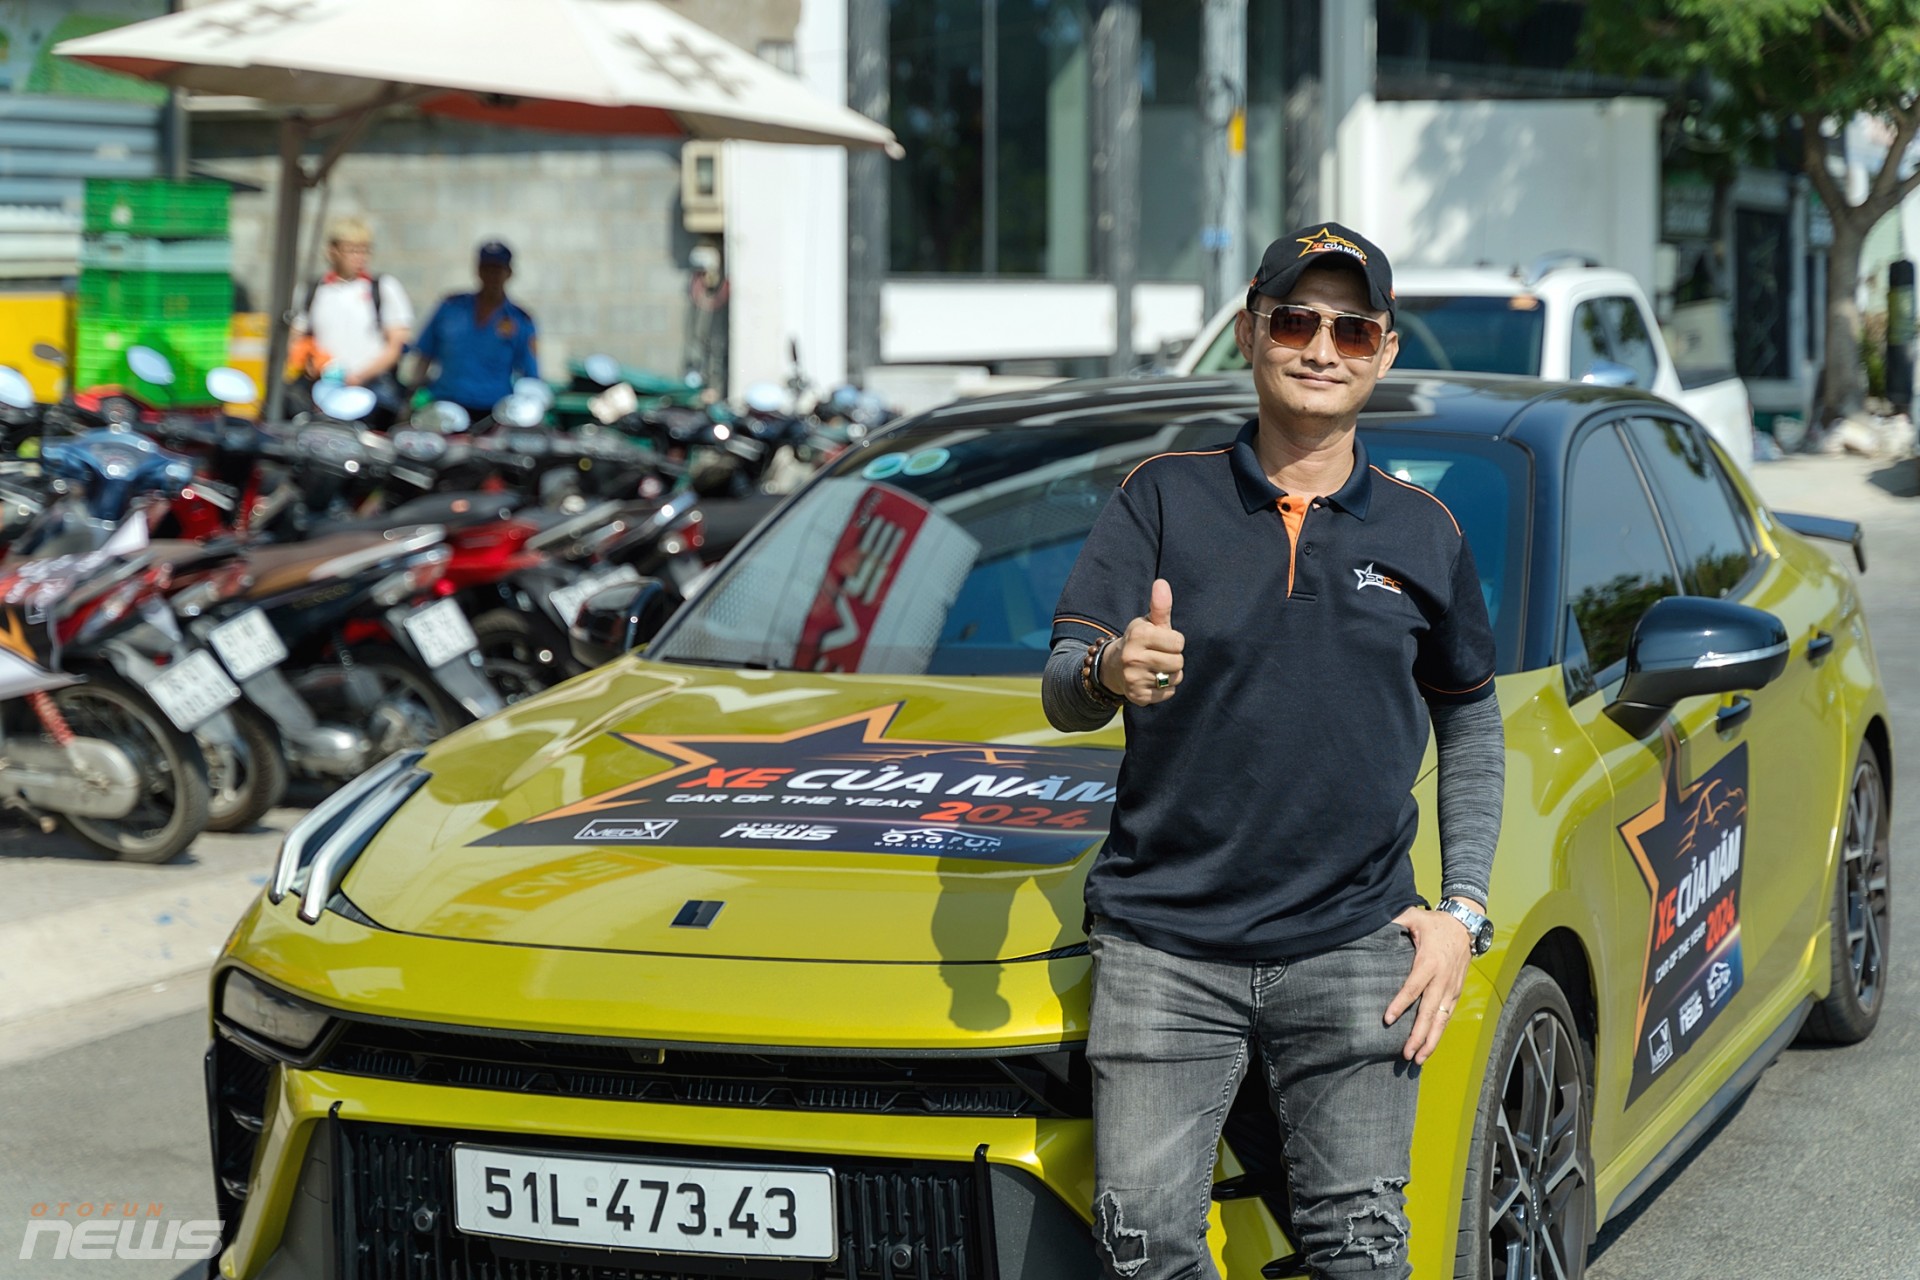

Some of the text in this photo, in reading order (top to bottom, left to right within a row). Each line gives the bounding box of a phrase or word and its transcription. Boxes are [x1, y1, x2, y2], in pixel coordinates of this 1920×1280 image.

[676, 767, 797, 788] XE
[786, 765, 944, 794] CỦA
[665, 793, 1093, 829] CAR OF THE YEAR 2024
[736, 822, 811, 830] OTOFUN
[1655, 886, 1678, 952] XE
[1676, 855, 1707, 928] CỦA
[1705, 888, 1736, 953] 2024
[484, 1165, 797, 1241] 51L-473.43
